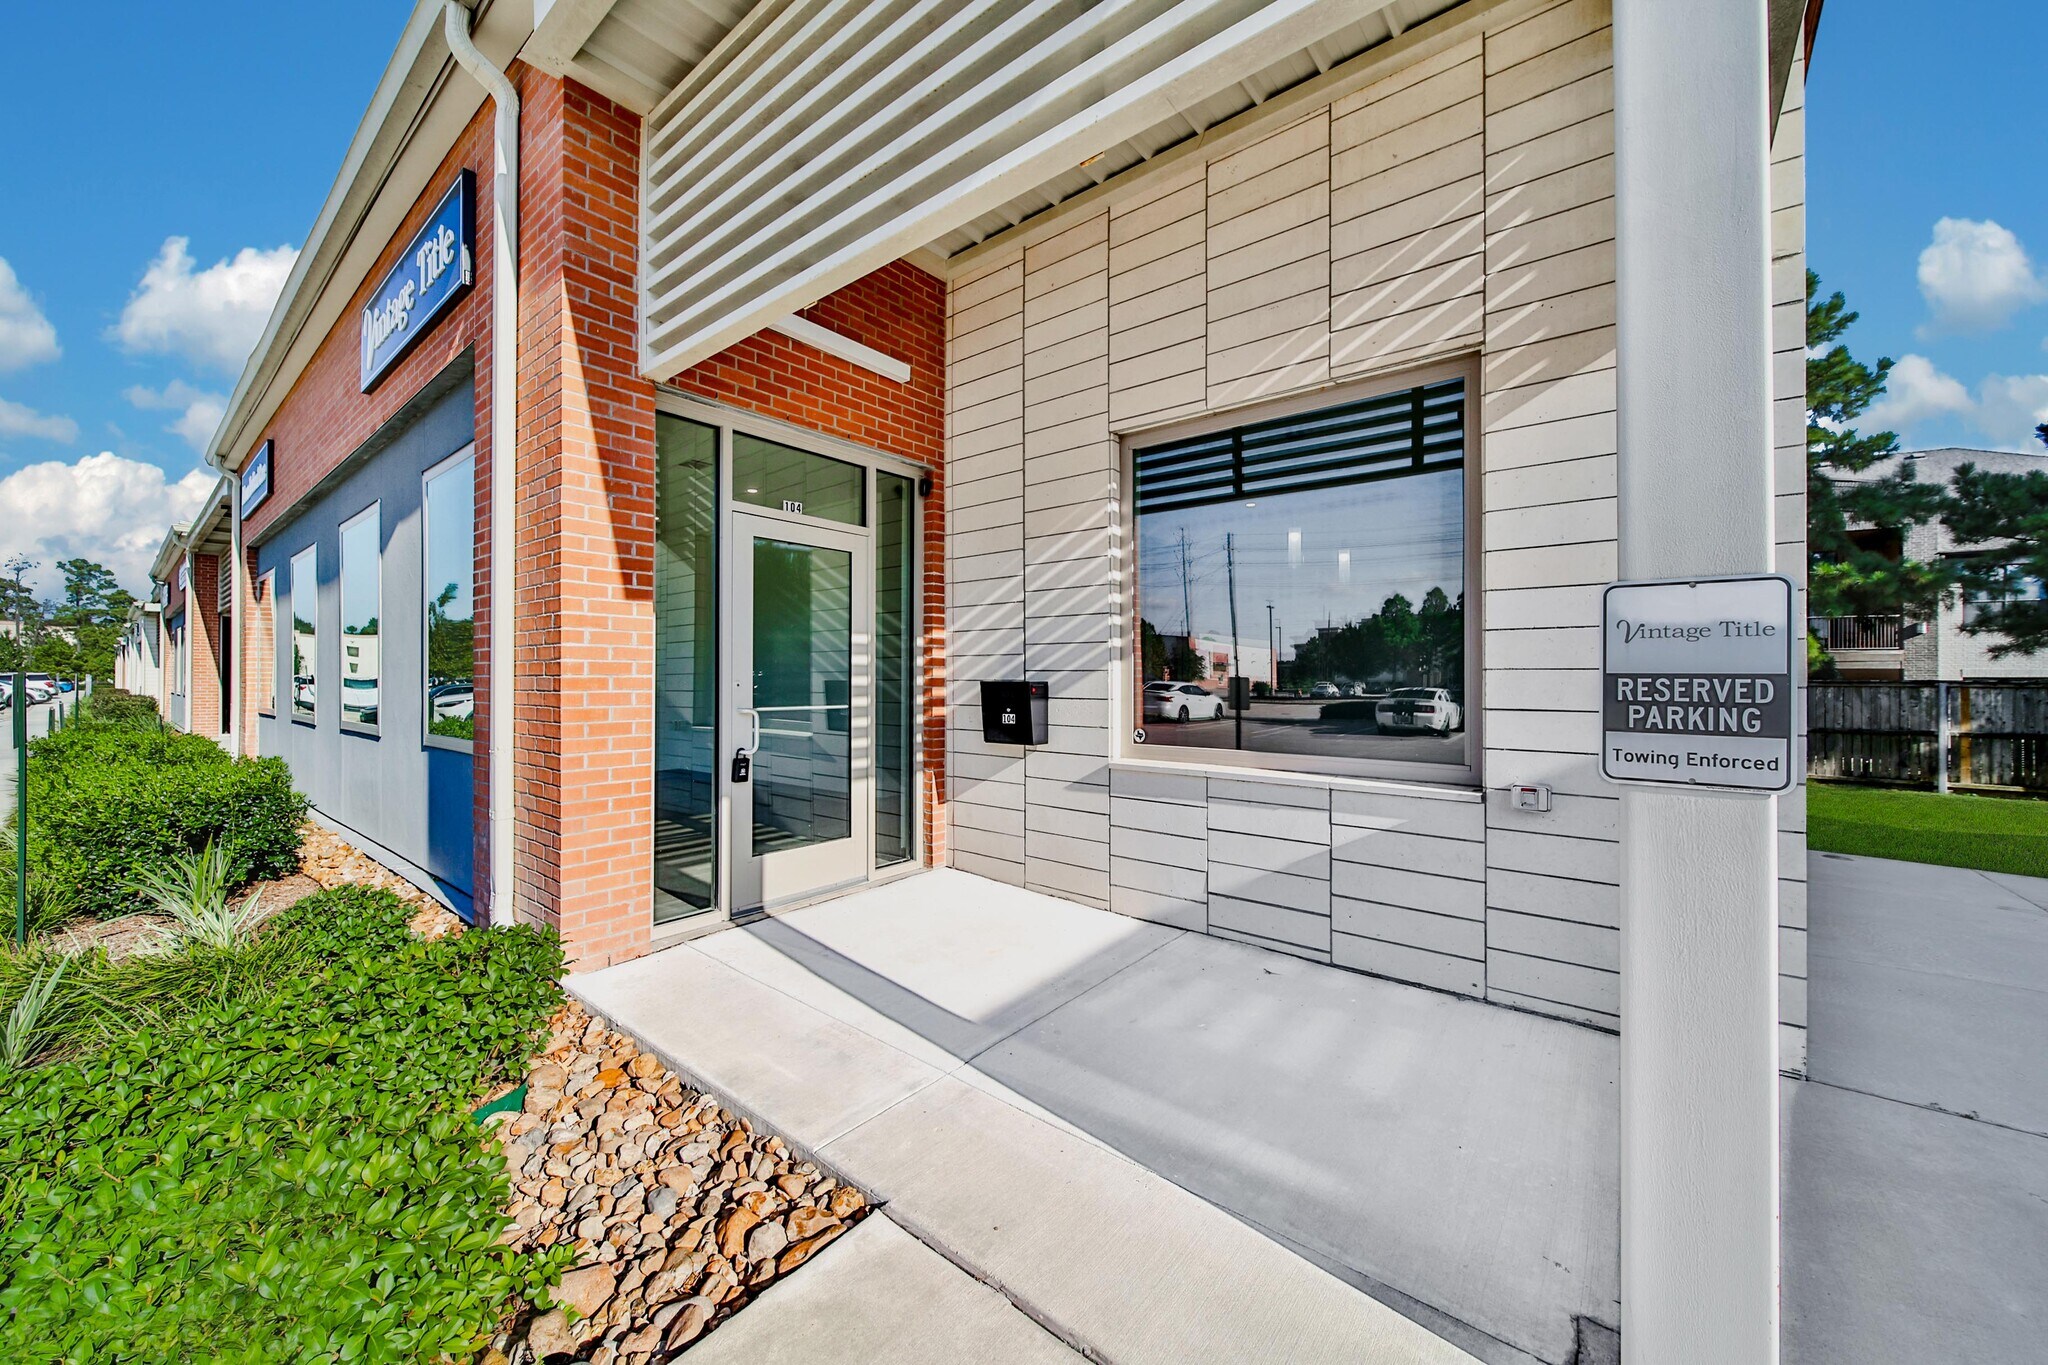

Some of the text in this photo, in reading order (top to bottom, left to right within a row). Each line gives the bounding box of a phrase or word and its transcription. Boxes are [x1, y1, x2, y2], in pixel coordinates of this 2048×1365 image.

[363, 224, 454, 370] Vintage Title
[785, 501, 801, 513] 104
[1616, 619, 1776, 644] Vintage Title
[1617, 677, 1774, 704] RESERVED
[1002, 714, 1015, 723] 104
[1628, 705, 1762, 733] PARKING
[1612, 748, 1779, 771] Towing Enforced
